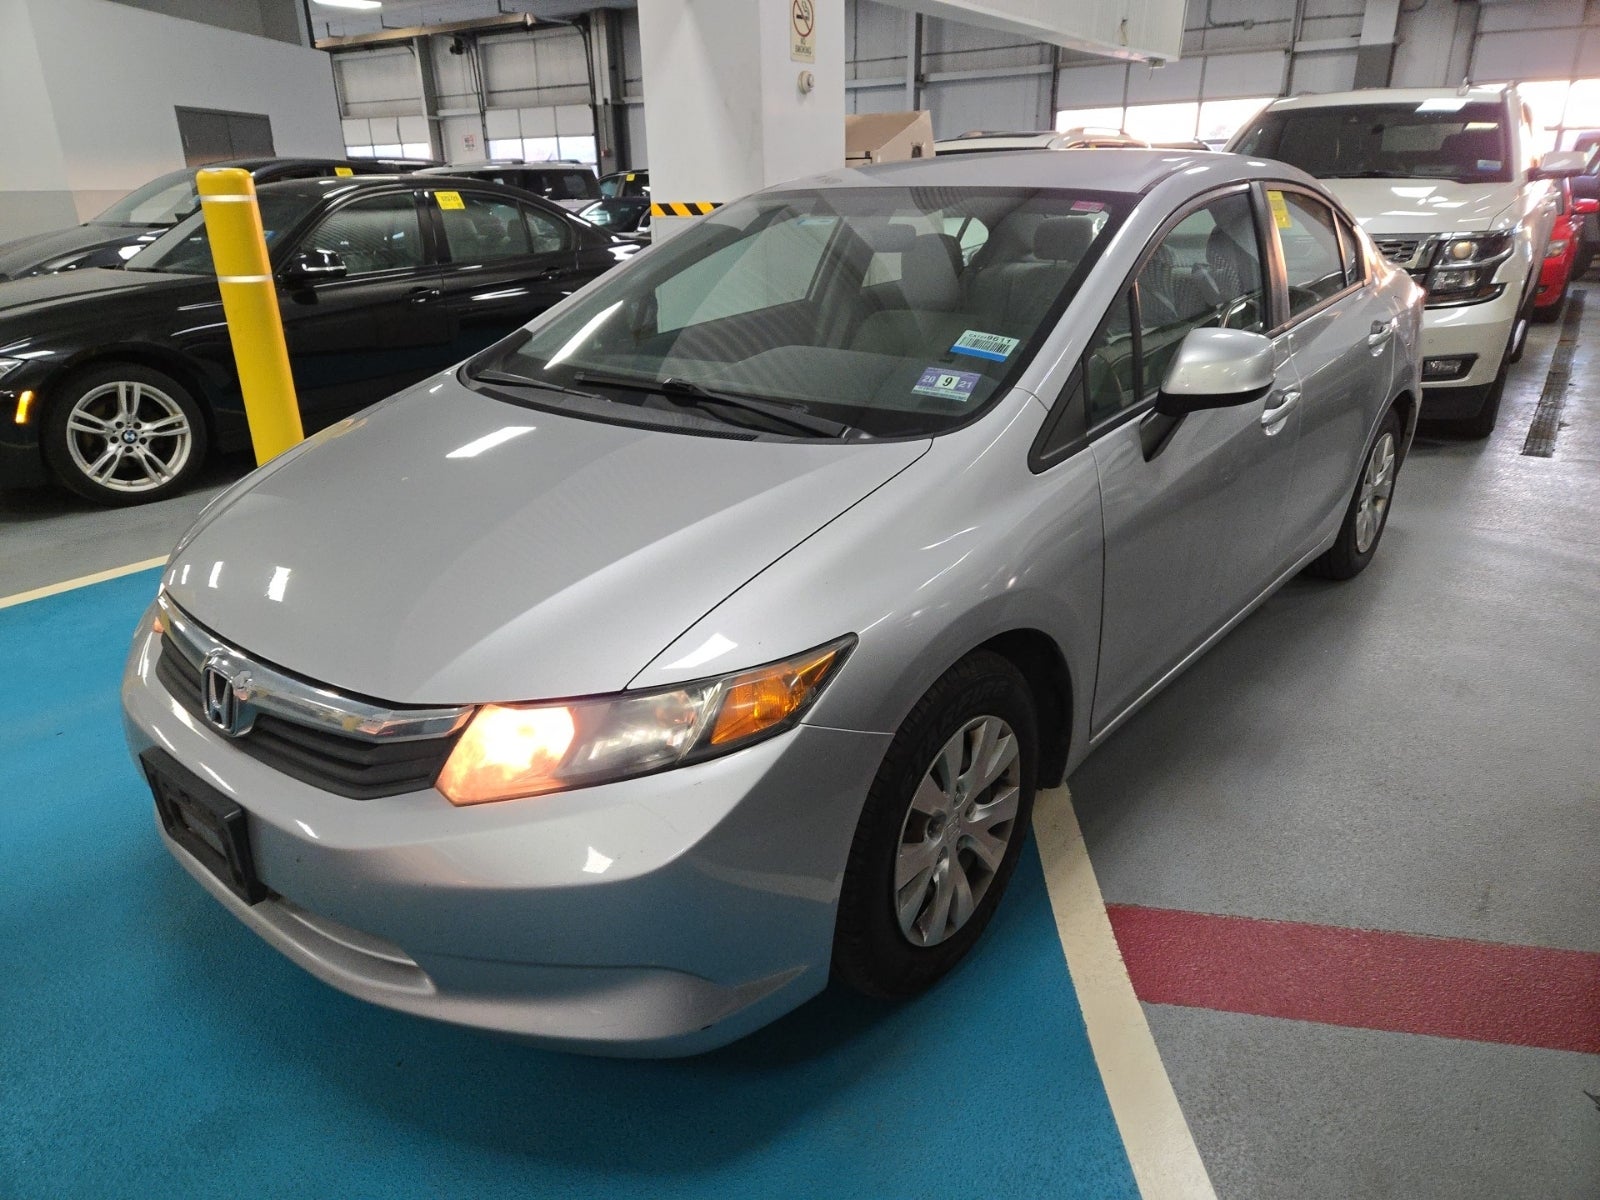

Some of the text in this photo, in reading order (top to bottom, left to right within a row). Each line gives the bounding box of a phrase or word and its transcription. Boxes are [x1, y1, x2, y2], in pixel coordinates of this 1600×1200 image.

[922, 375, 972, 388] 20 9 21
